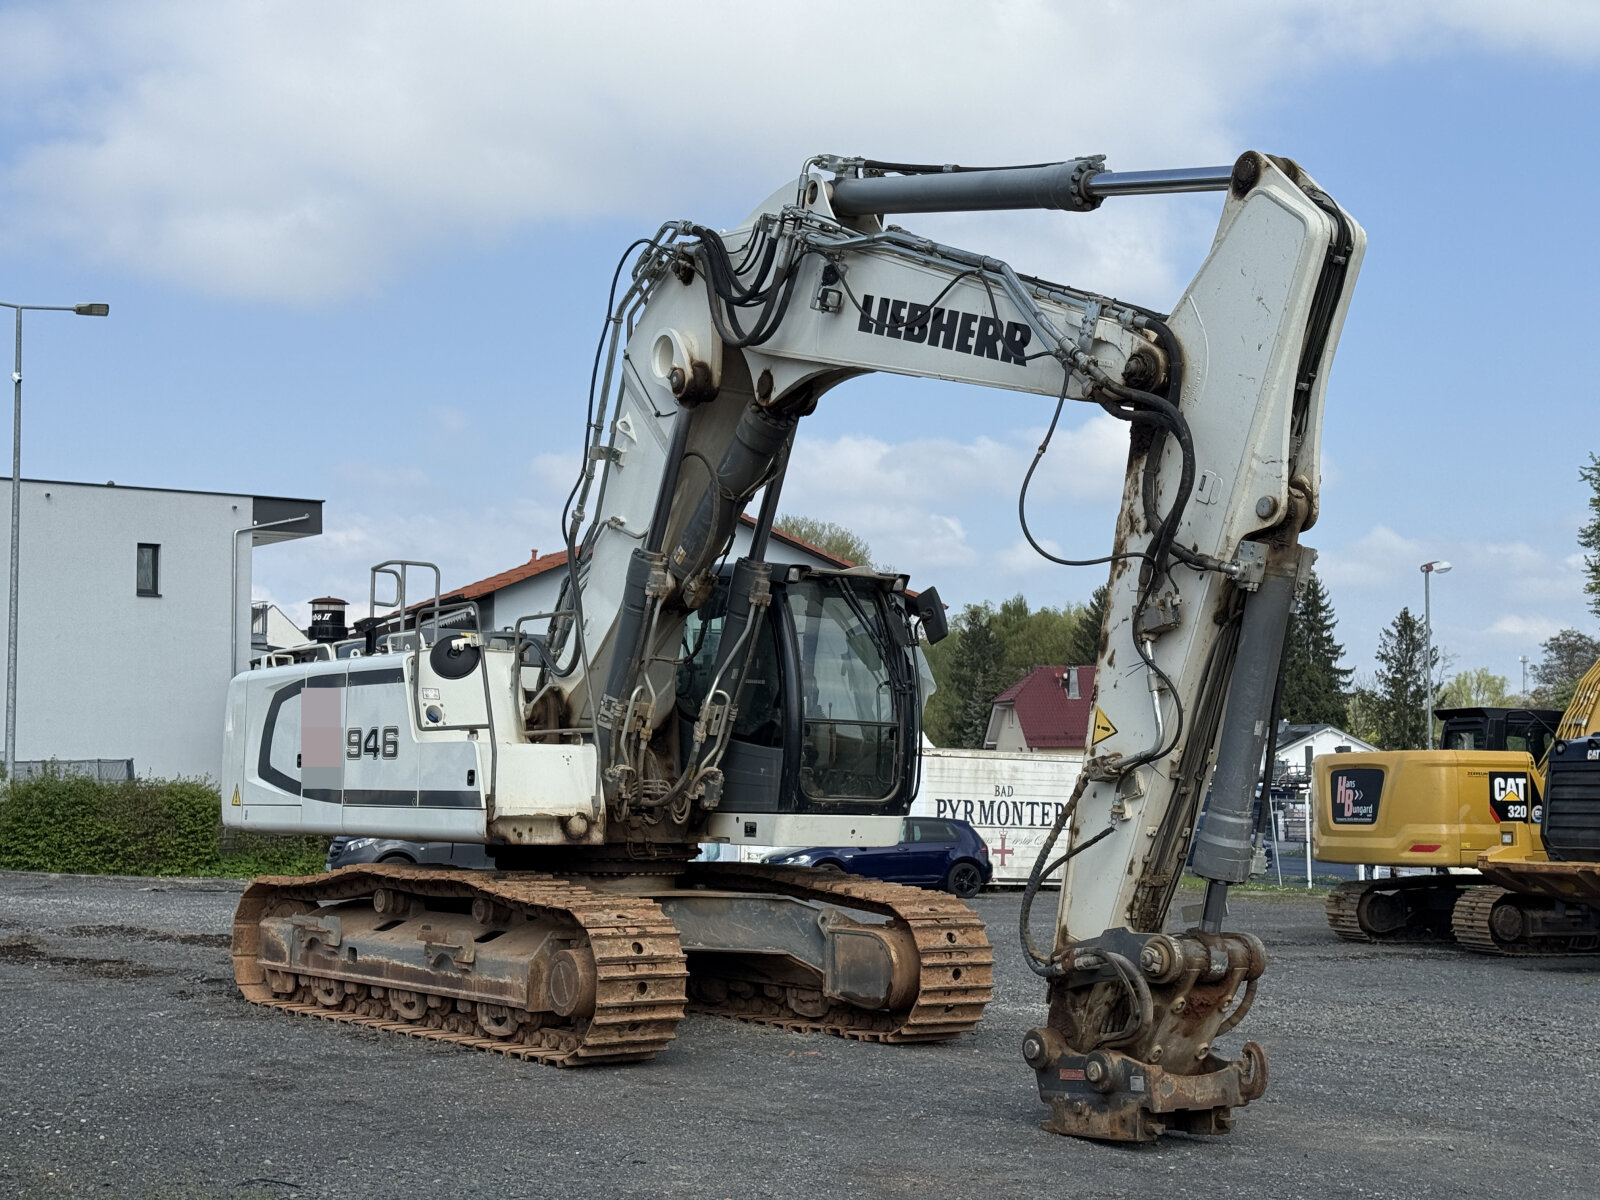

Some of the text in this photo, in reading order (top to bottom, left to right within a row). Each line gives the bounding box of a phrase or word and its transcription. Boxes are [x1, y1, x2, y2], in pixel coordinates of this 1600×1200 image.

[858, 294, 1032, 367] LIEBHERR
[346, 725, 399, 760] 946
[1587, 750, 1600, 760] CAT
[994, 785, 1014, 797] BAD
[1336, 775, 1356, 804] Hans
[1494, 777, 1526, 801] CAT
[1344, 789, 1373, 817] Bungard
[1507, 805, 1527, 818] 320
